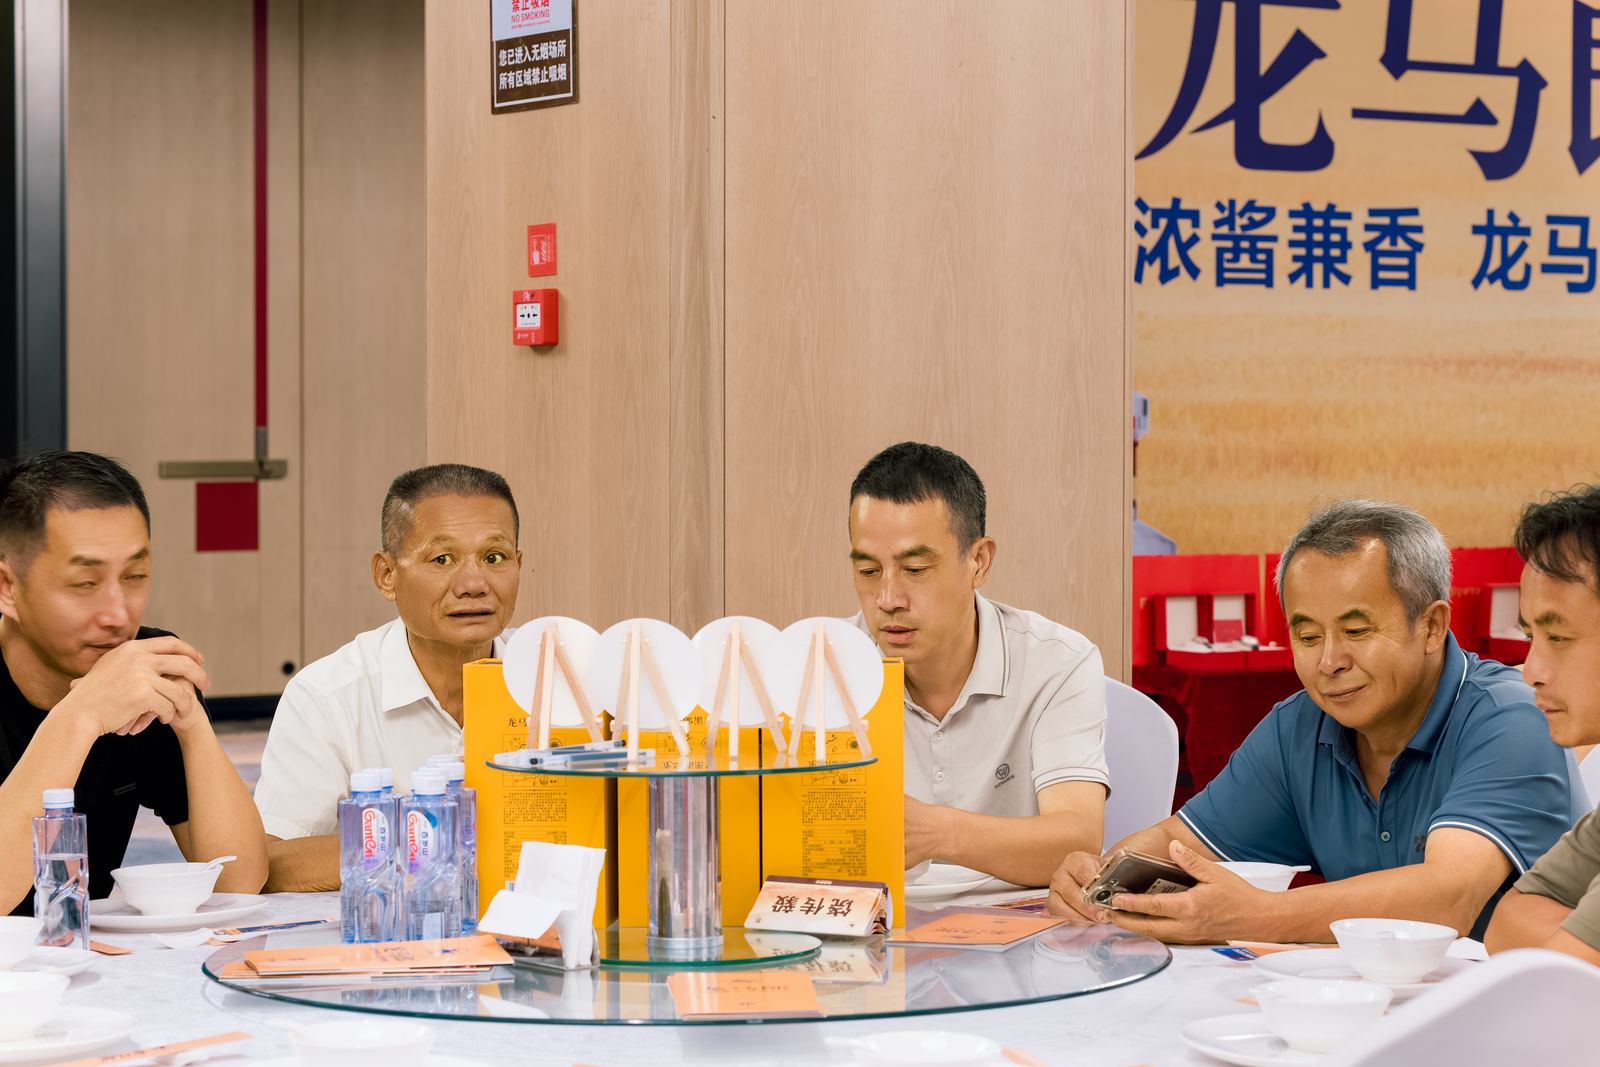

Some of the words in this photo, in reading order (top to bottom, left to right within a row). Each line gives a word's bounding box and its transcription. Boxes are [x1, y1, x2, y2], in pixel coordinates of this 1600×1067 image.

[511, 14, 520, 22] NO
[521, 9, 550, 21] SMOKING
[499, 40, 566, 66] 您已进入无烟场所
[499, 63, 566, 90] 所有区域禁止吸烟
[1134, 0, 1600, 180] 龙马
[1134, 197, 1424, 290] 浓酱兼香
[1471, 208, 1597, 293] 龙马
[364, 810, 377, 858] Ganten
